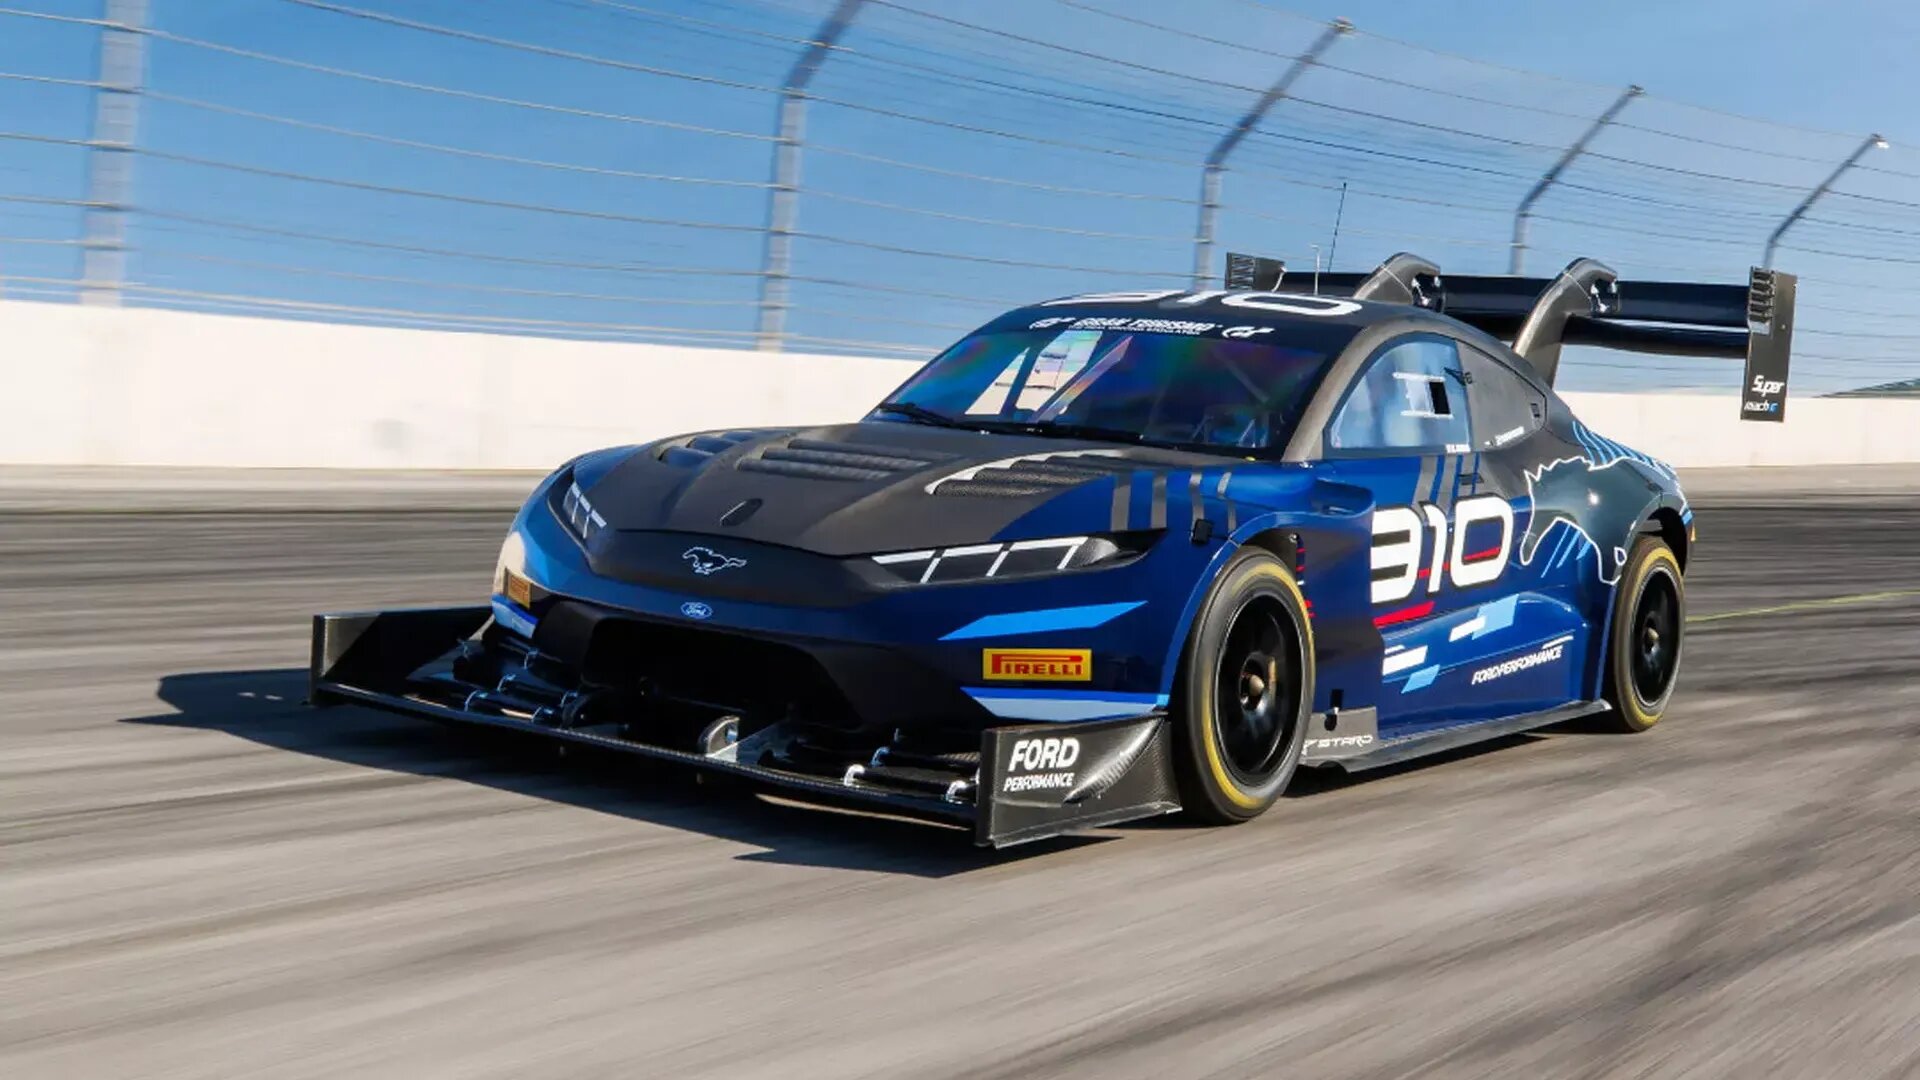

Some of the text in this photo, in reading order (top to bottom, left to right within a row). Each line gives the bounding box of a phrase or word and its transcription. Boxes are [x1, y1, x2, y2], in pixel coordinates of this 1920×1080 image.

[1752, 374, 1785, 398] Super
[1370, 496, 1514, 604] 310
[991, 653, 1084, 675] PIRELLI
[1007, 737, 1080, 772] FORD
[1002, 772, 1075, 792] PERFORMANCE
